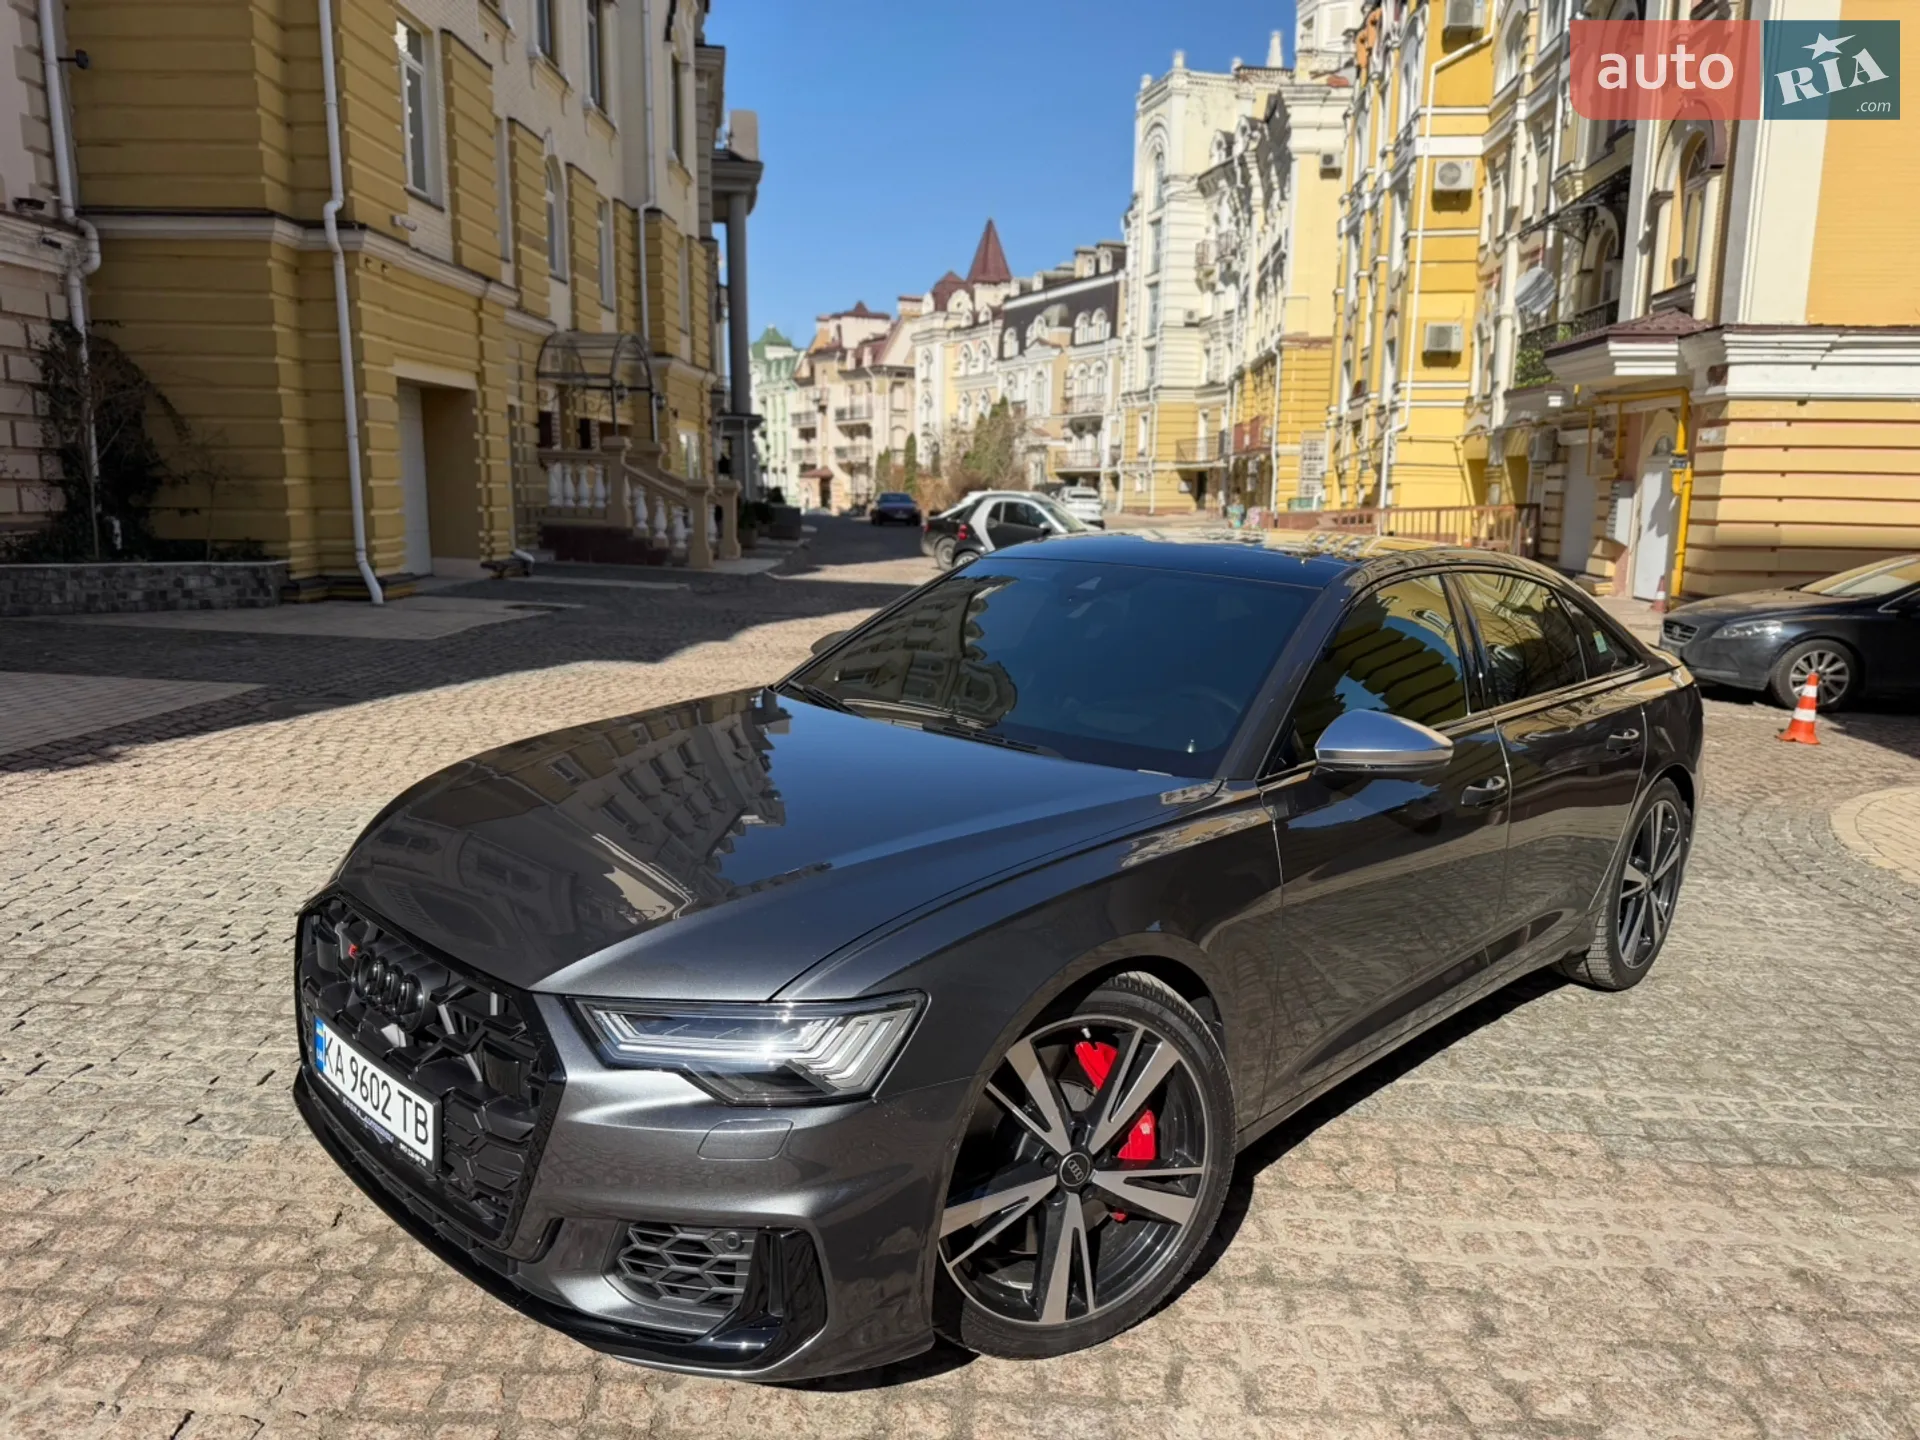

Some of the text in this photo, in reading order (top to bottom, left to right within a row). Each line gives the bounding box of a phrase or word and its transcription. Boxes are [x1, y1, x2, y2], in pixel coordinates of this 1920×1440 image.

[324, 1030, 346, 1085] KA
[350, 1056, 392, 1122] 9602
[397, 1089, 429, 1145] TB
